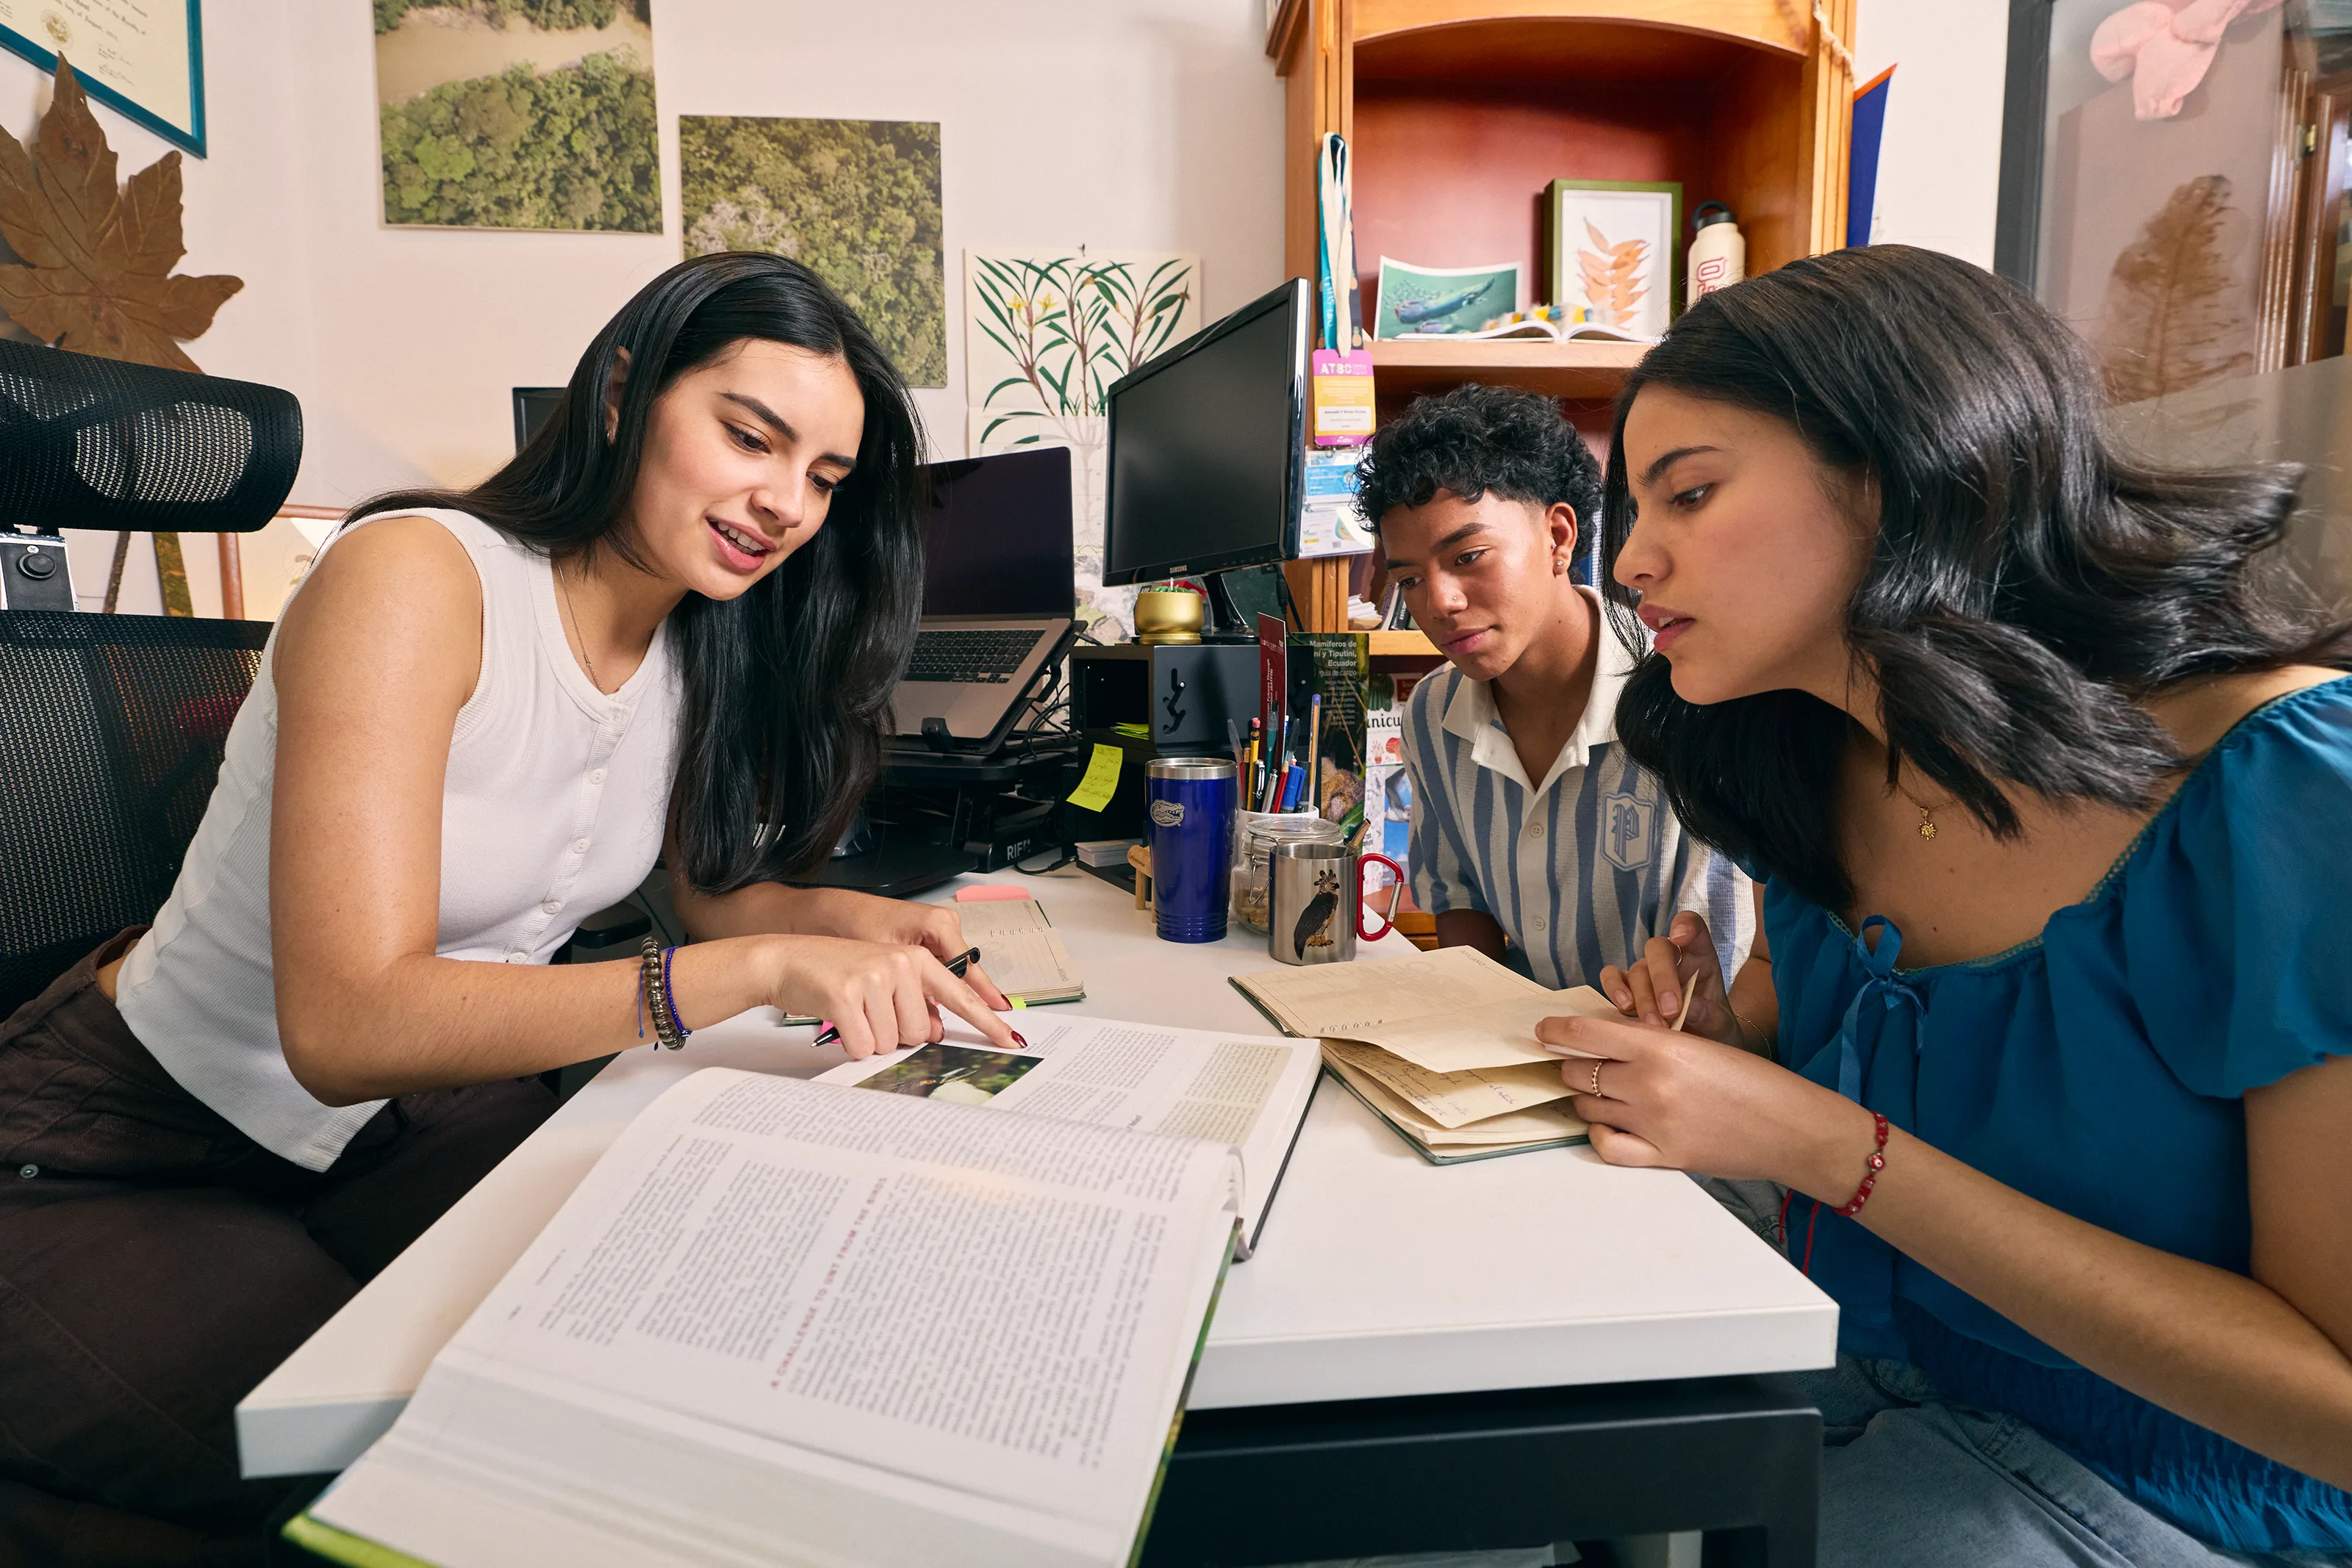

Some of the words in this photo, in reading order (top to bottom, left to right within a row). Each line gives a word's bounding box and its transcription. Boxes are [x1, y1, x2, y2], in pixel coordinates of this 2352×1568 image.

[1169, 564, 1187, 574] SAMSUNG
[1328, 650, 1357, 658] Tiputini,
[1328, 659, 1357, 667] Ecuador
[770, 1380, 779, 1389] A
[775, 1306, 817, 1376] CHALLENGE
[814, 1287, 827, 1302] TO
[836, 1229, 857, 1259] FROM
[854, 1208, 870, 1226] THE
[866, 1176, 887, 1205] BIRDS
